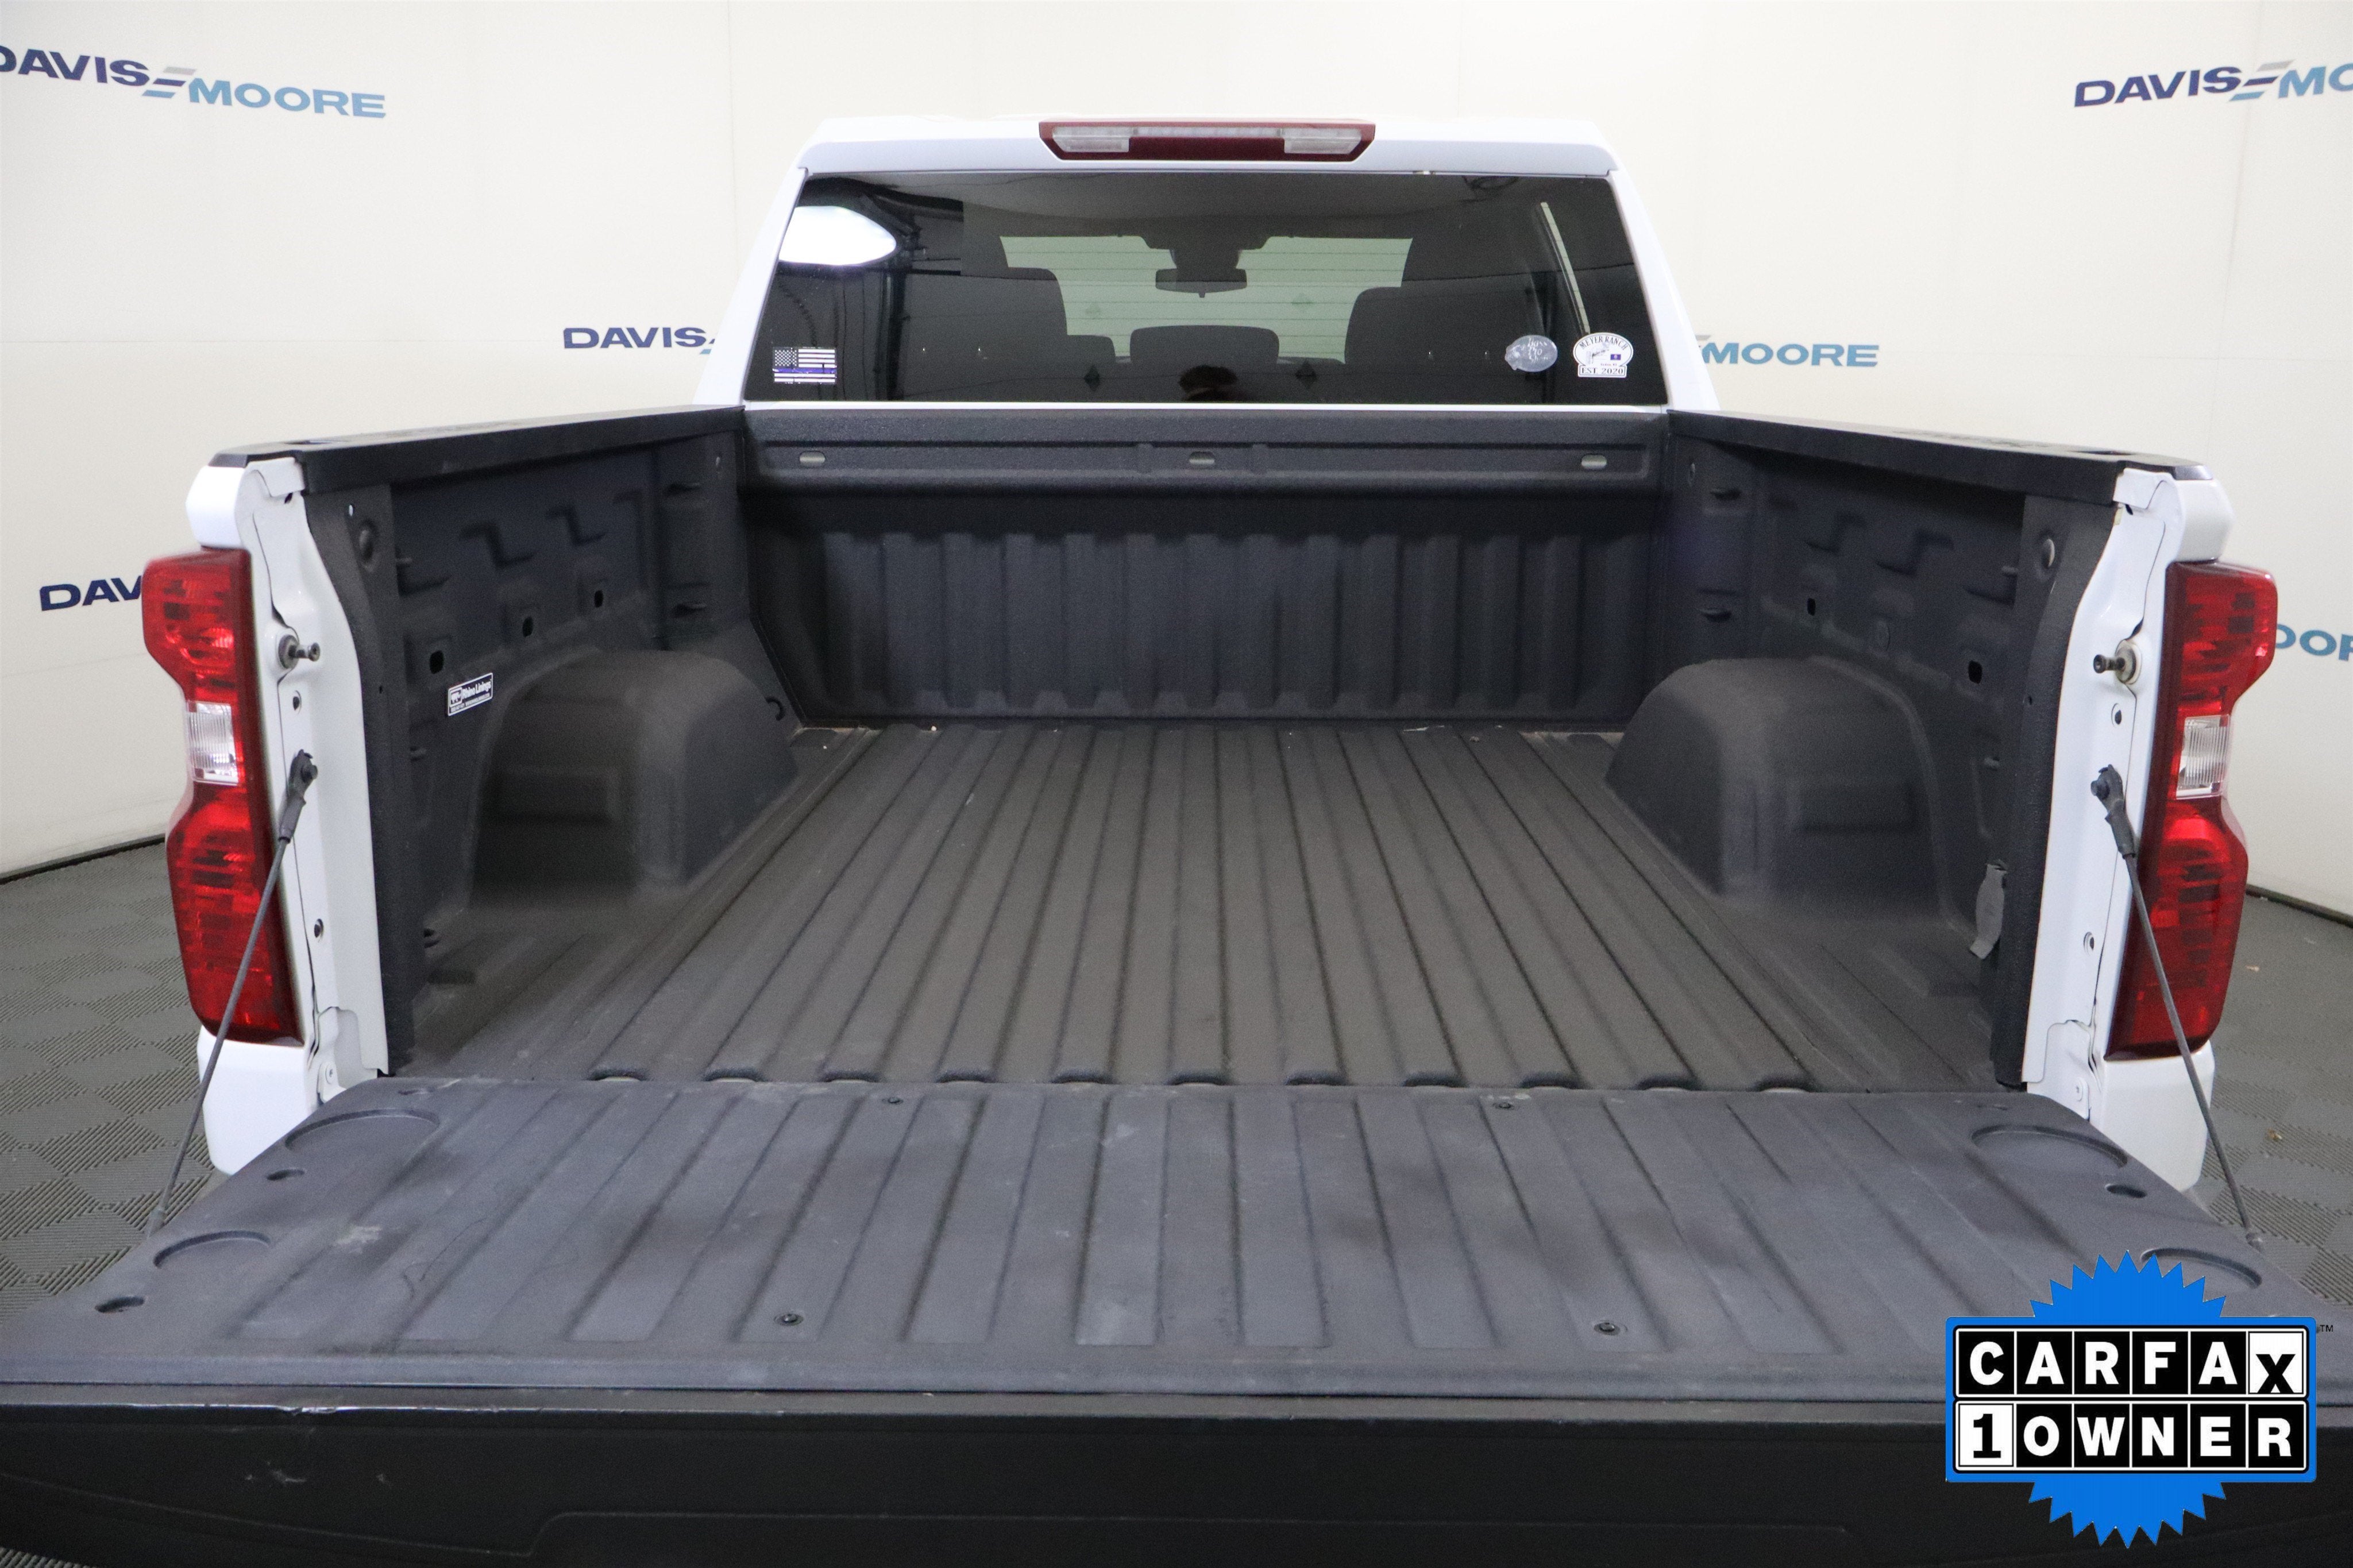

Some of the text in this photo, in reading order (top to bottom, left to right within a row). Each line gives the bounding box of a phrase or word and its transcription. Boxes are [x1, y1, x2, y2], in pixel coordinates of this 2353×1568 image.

[188, 78, 386, 118] MOORE
[2074, 67, 2242, 107] DAVIS
[563, 327, 706, 349] DAVIS
[1580, 336, 1628, 350] MEYER RANCH
[1702, 342, 1879, 367] MOORE
[39, 575, 142, 611] DAV
